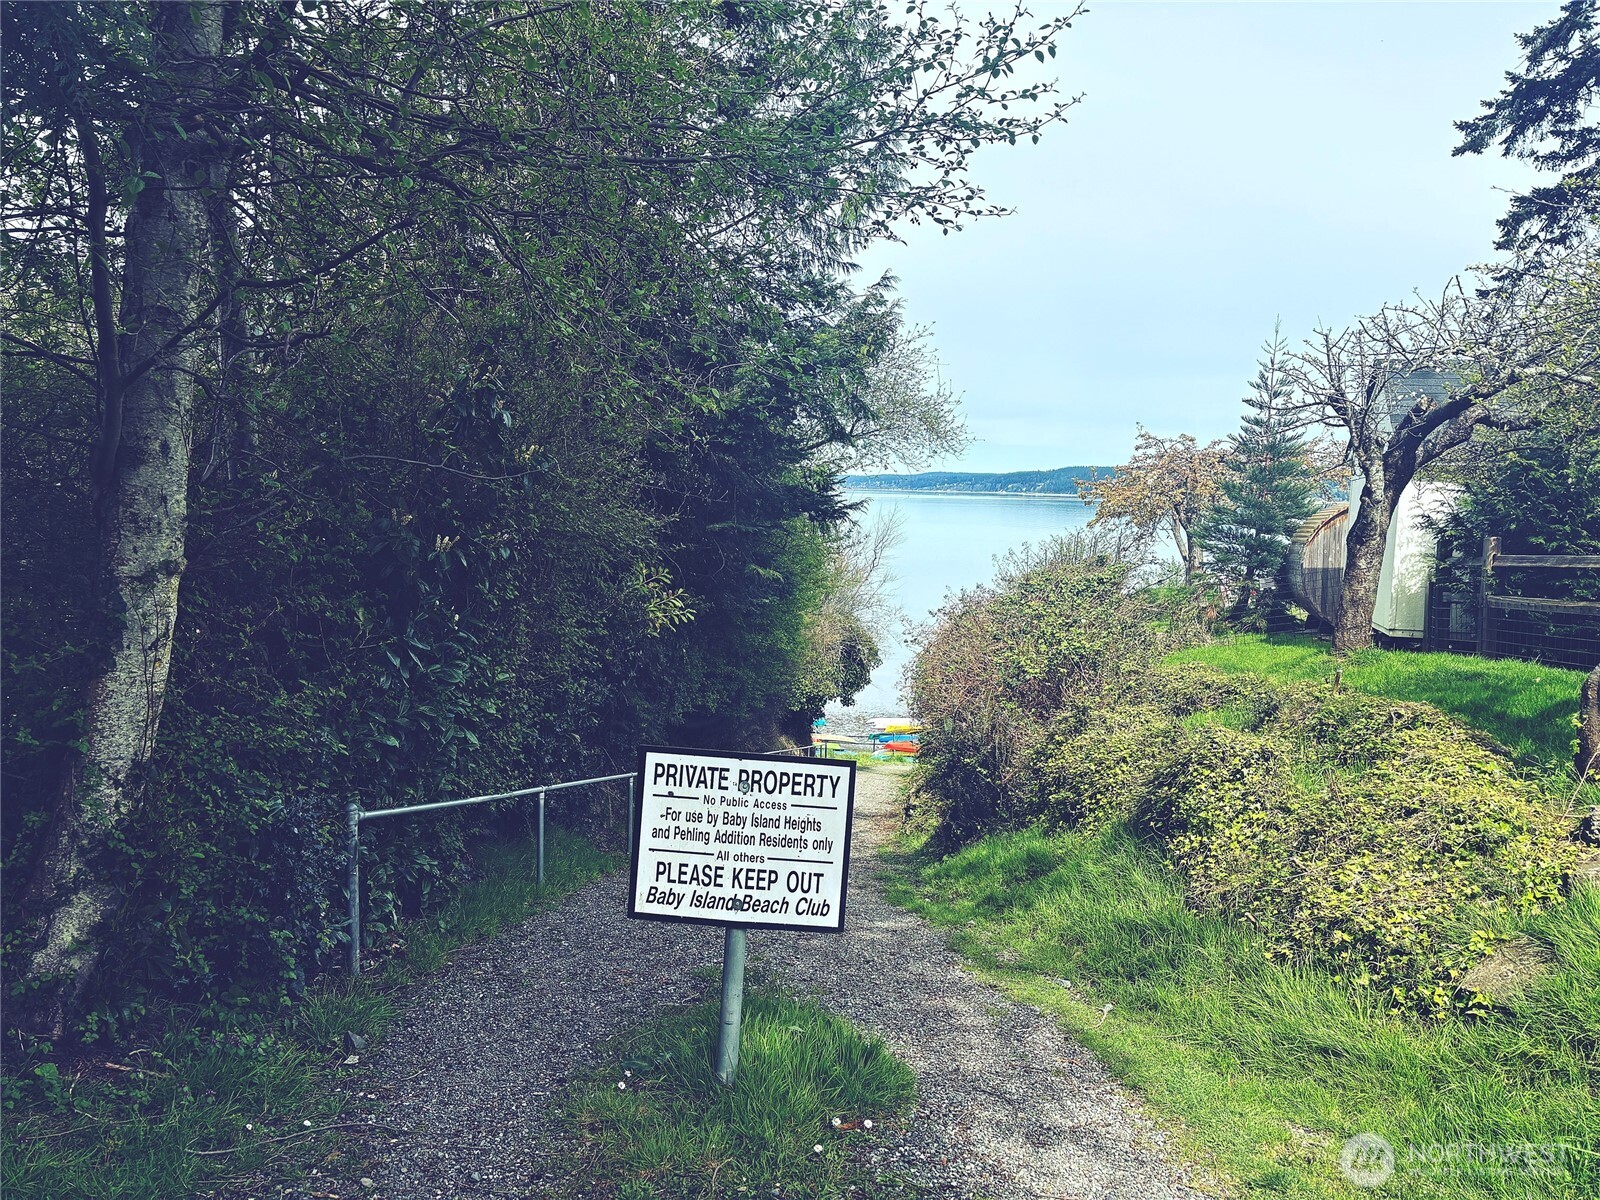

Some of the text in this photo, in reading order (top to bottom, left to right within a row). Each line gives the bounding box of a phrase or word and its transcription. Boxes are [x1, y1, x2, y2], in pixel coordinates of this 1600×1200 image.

[653, 762, 841, 799] PRIVATE PROPERTY
[703, 794, 788, 811] No Public Access
[685, 811, 703, 823] use
[707, 811, 719, 827] by
[722, 813, 747, 829] Baby
[751, 813, 781, 829] Island
[784, 815, 822, 833] Heights
[651, 825, 834, 854] and Pehling Addition Residents only
[716, 850, 765, 864] All others
[655, 861, 825, 894] PLEASE KEEP OUT
[645, 886, 831, 917] Baby Island Beach Club
